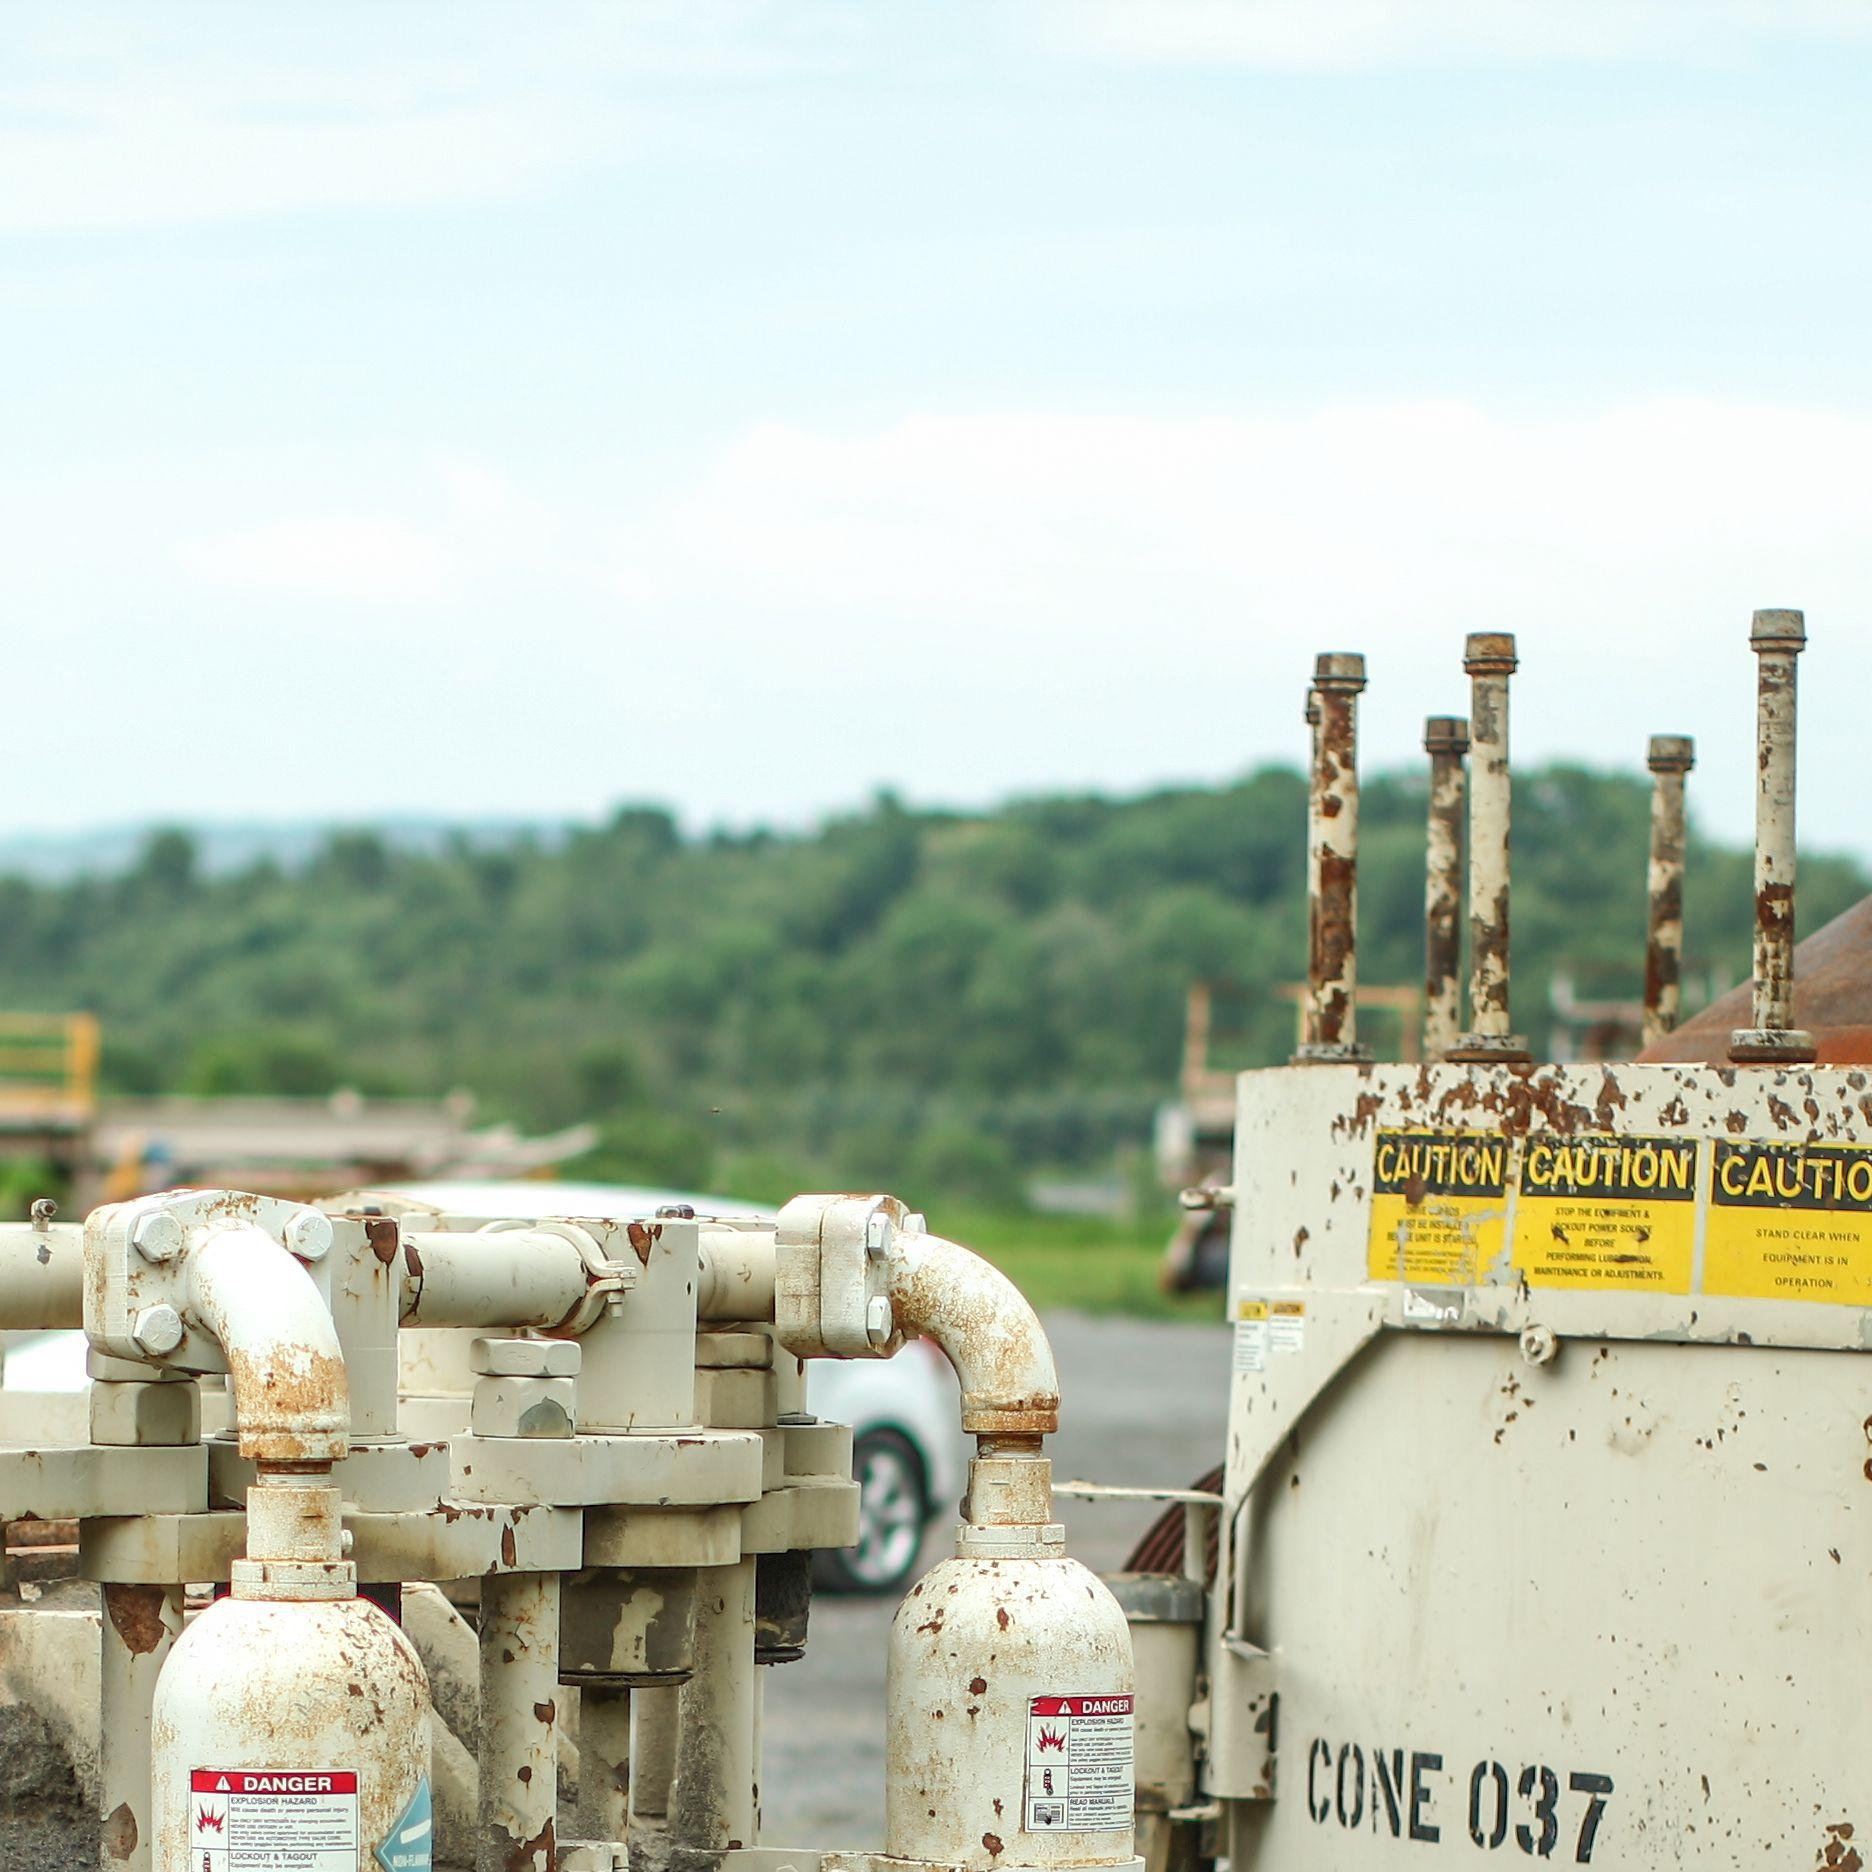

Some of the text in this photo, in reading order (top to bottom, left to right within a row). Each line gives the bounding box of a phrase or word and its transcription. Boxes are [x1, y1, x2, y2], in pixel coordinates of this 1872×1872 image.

[1378, 1144, 1503, 1186] CAUTION
[1528, 1145, 1688, 1189] CAUTION
[1555, 1207, 1575, 1215] STOP
[1578, 1208, 1591, 1216] THE
[1589, 1224, 1617, 1232] POWER
[1756, 1228, 1860, 1242] STAND CLEAR WHEN
[1584, 1238, 1616, 1248] BEFORE
[1546, 1252, 1596, 1262] PERFORMING
[1763, 1253, 1849, 1266] EQUIPMENT IS IN
[1534, 1267, 1588, 1277] MAINTENANCE
[1590, 1268, 1602, 1277] OR
[1082, 1700, 1129, 1713] DANGER
[244, 1777, 332, 1791] DANGER
[231, 1797, 317, 1805] EXPLOSION HAZARD
[1307, 1737, 1615, 1864] CONE 037
